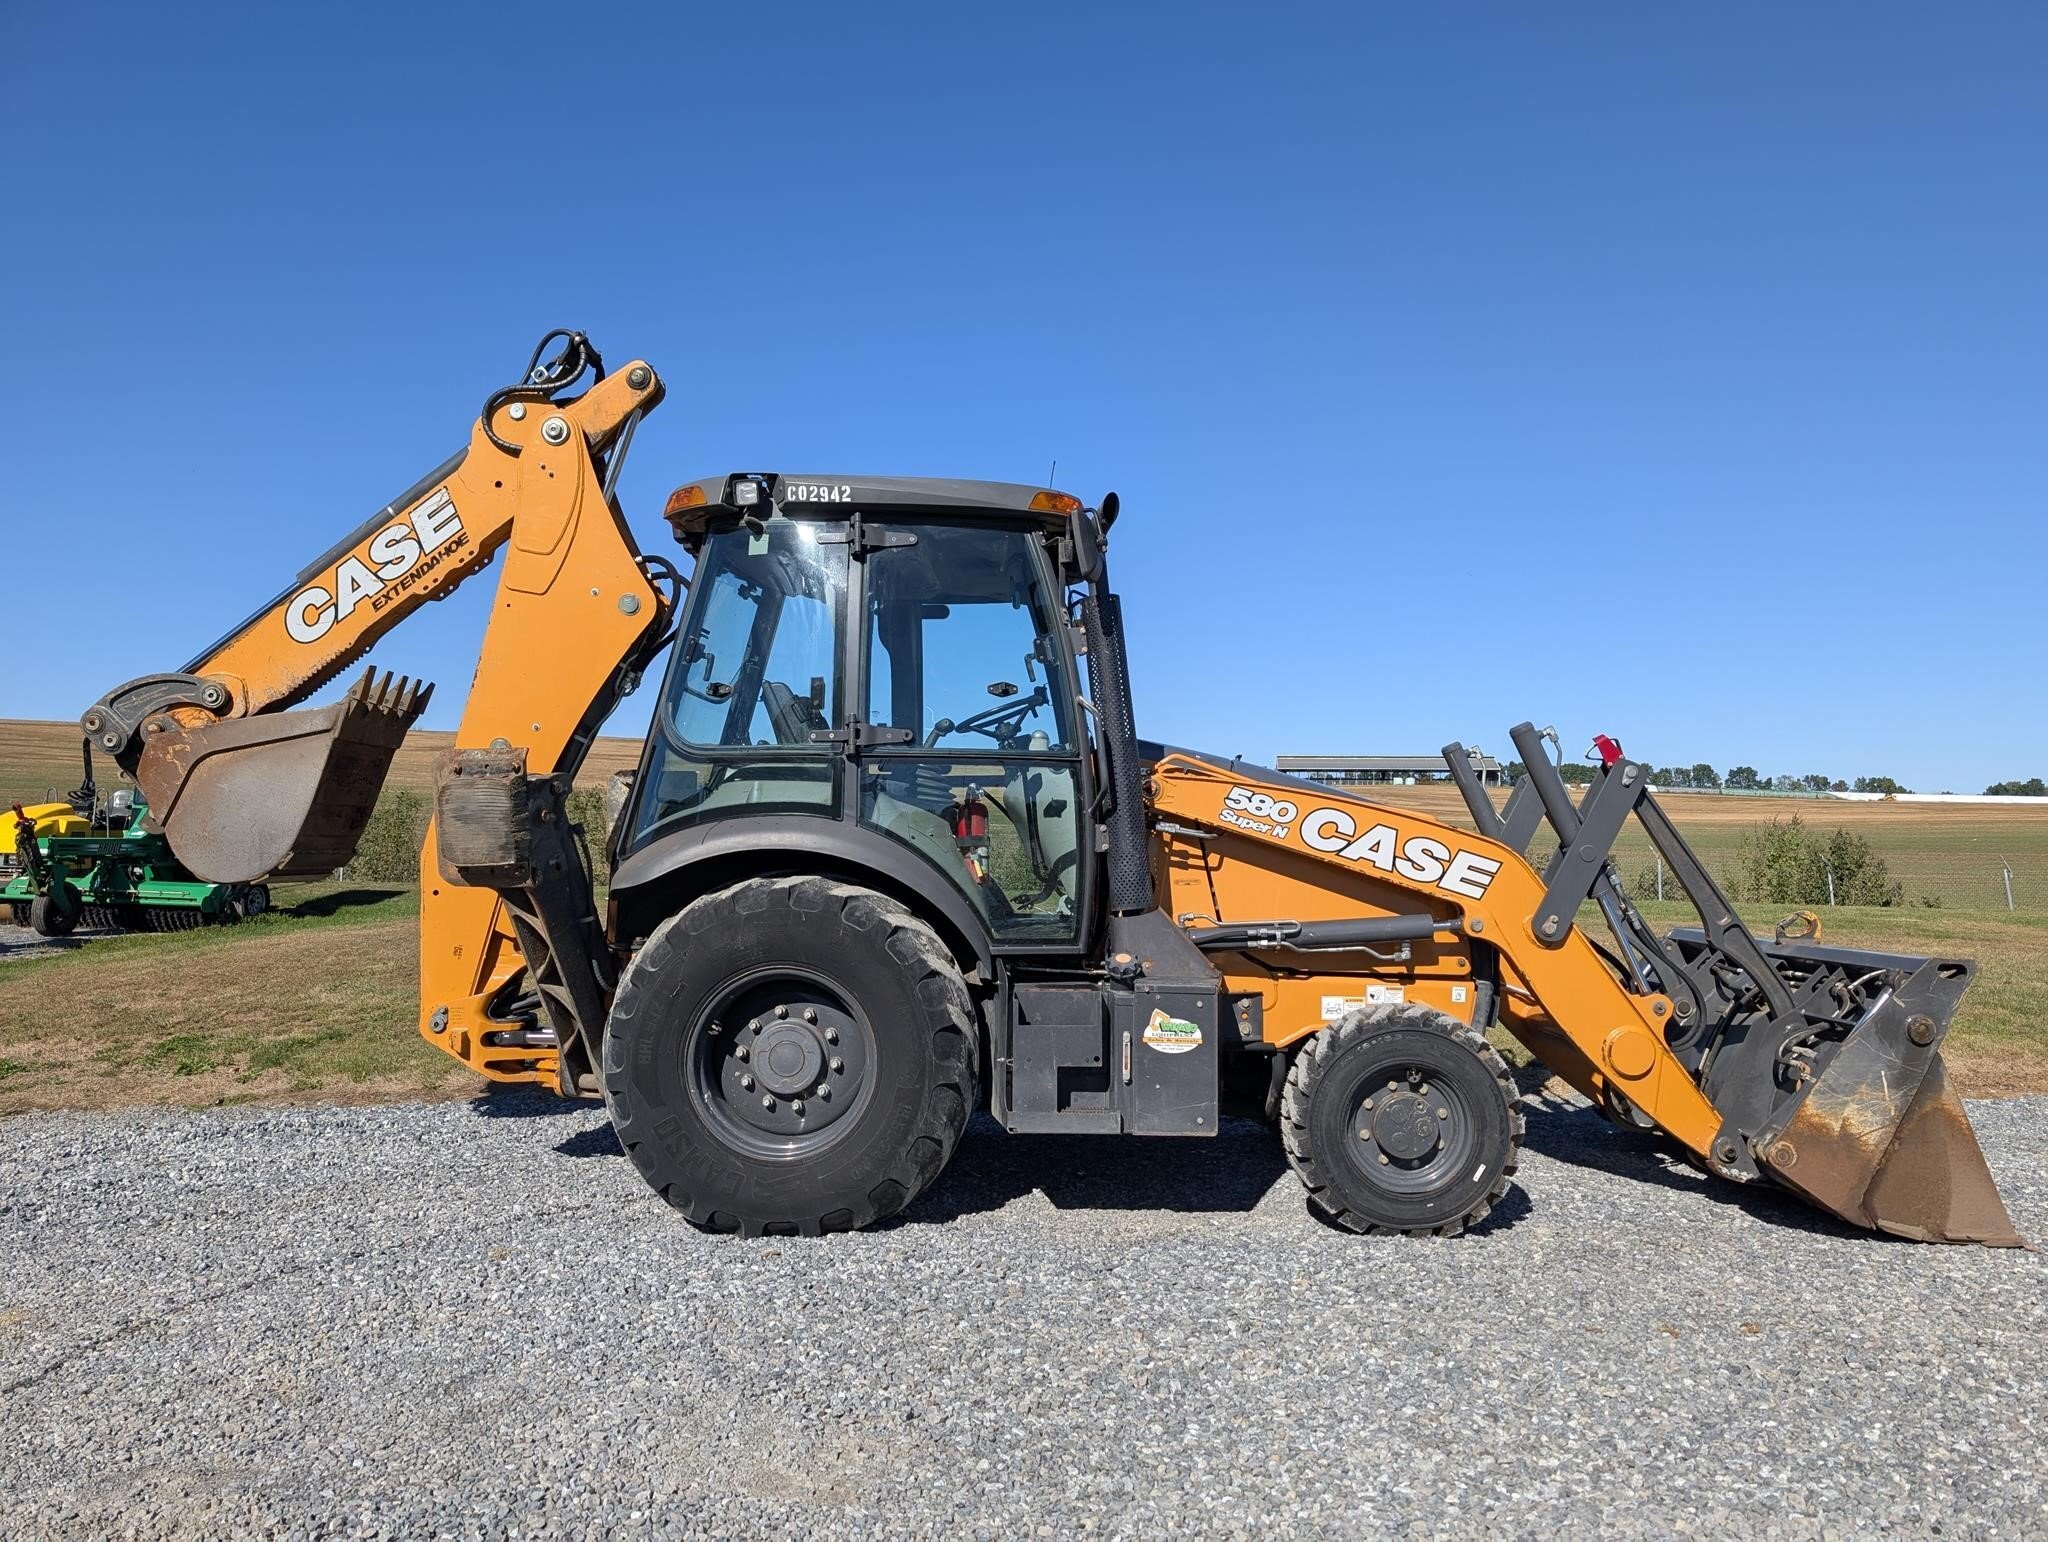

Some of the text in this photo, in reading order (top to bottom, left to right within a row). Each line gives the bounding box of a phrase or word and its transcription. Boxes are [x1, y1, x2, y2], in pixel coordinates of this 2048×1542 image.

[285, 486, 464, 644] CASE
[372, 532, 470, 612] EXTENDAHOE
[1219, 808, 1290, 840] Super N
[1224, 785, 1298, 824] 580
[1300, 807, 1503, 901] CASE
